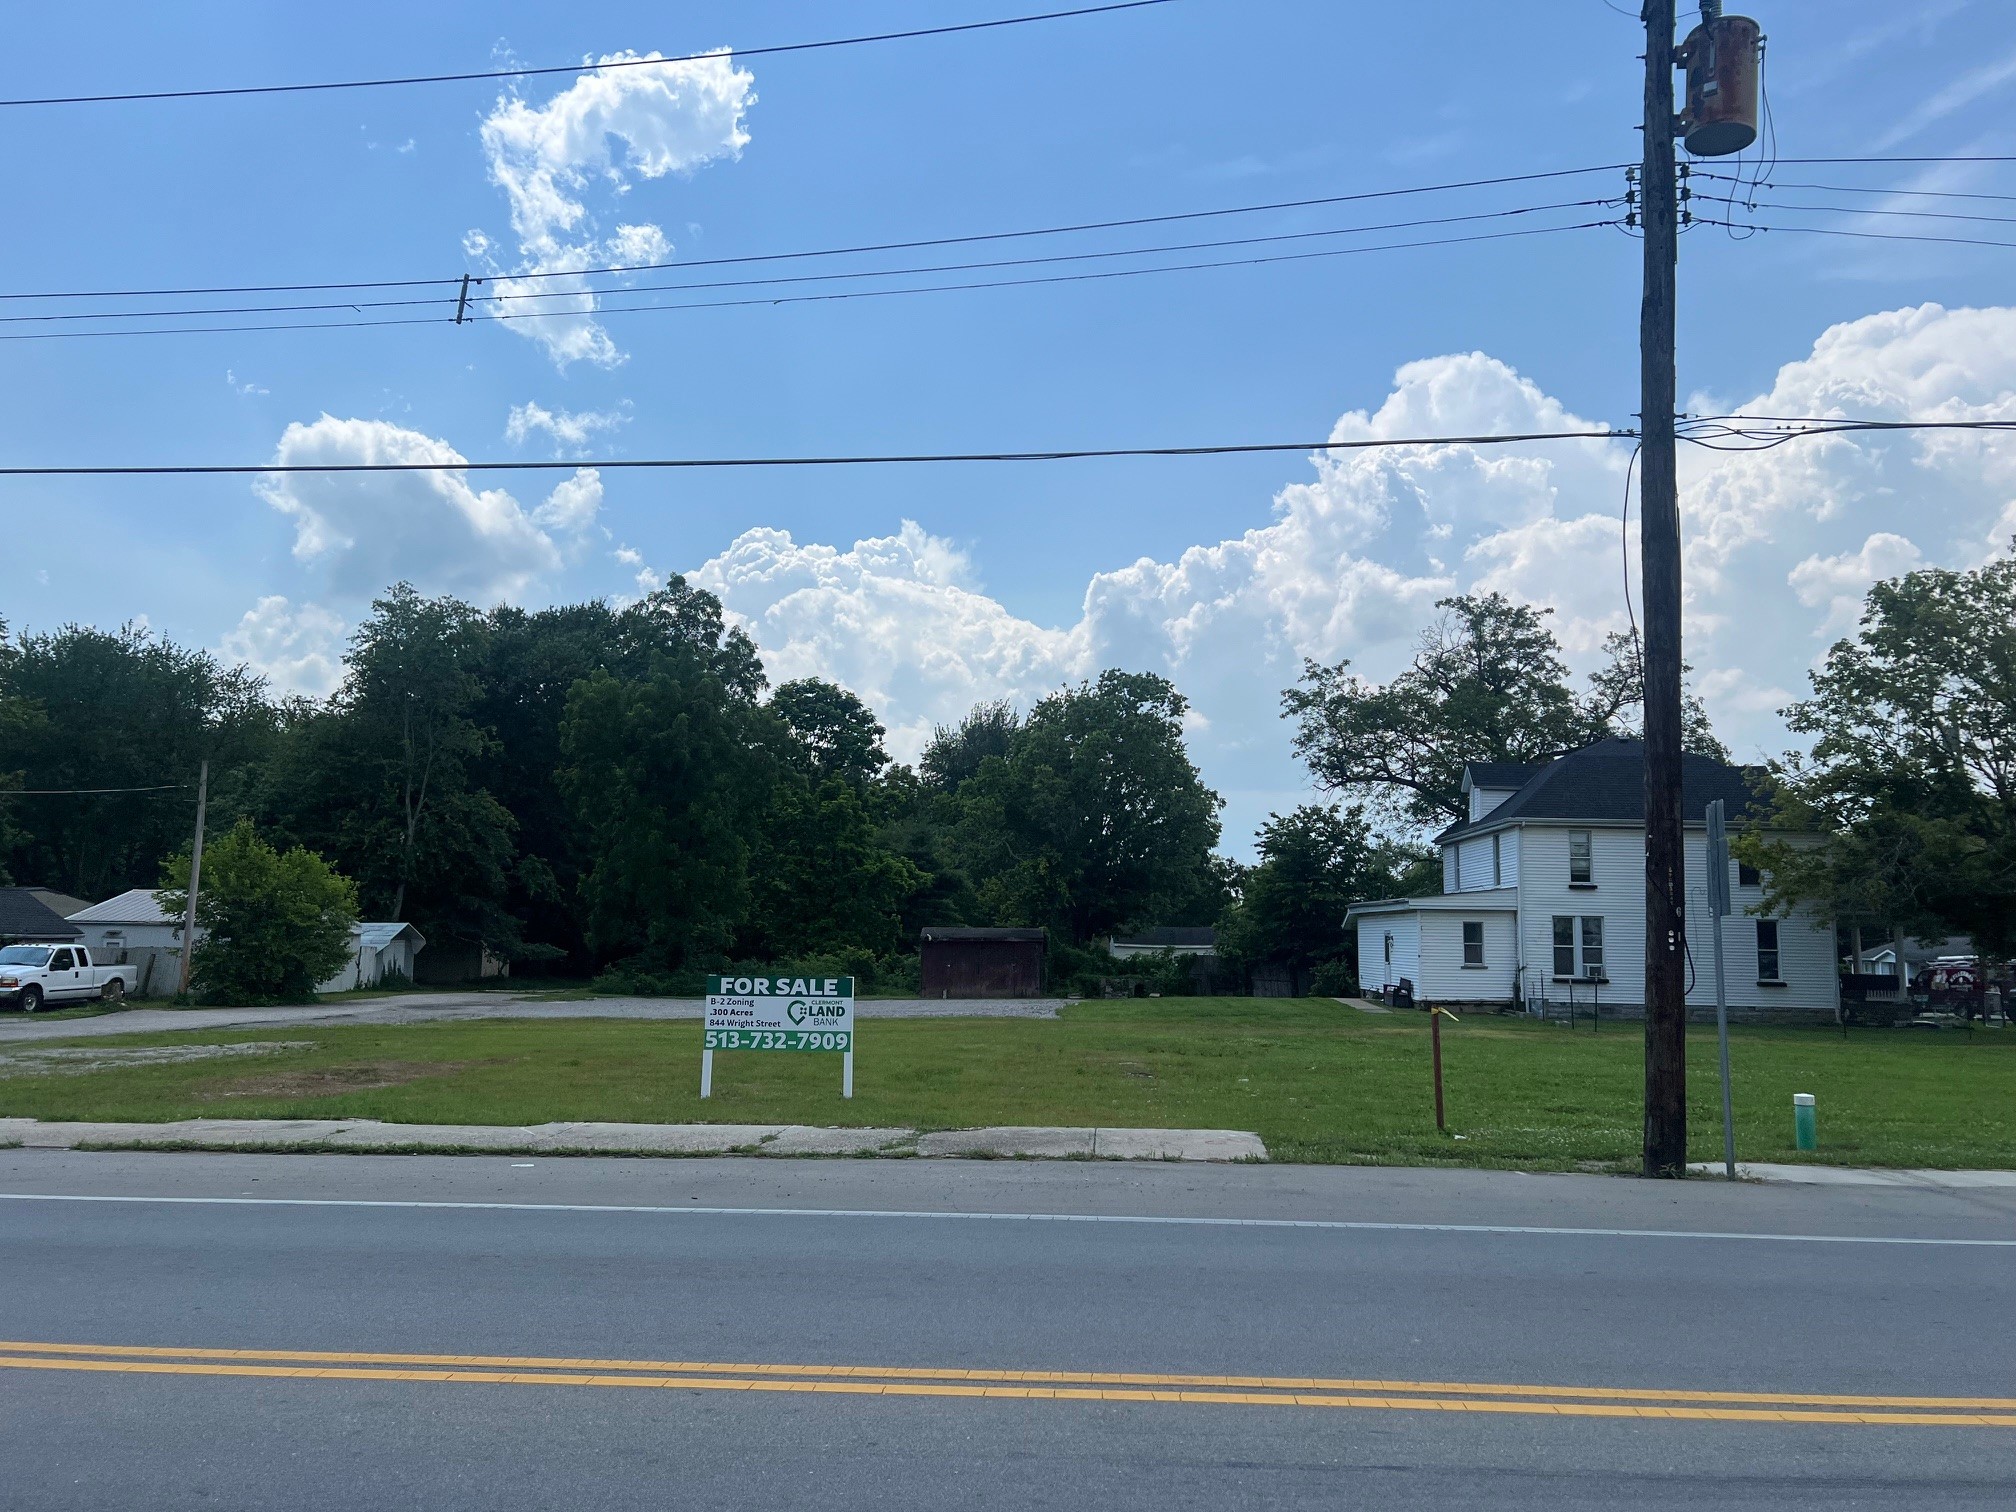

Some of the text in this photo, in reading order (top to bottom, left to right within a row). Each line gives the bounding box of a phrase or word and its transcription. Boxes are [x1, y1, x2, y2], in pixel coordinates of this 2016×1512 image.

[720, 977, 838, 995] FOR SALE
[727, 998, 755, 1007] Zoning
[709, 1008, 728, 1016] .300
[809, 1006, 846, 1017] LAND
[727, 1019, 754, 1028] Wright
[755, 1019, 781, 1027] Street
[813, 1018, 839, 1026] BANK
[705, 1031, 848, 1050] 513-732-7909
